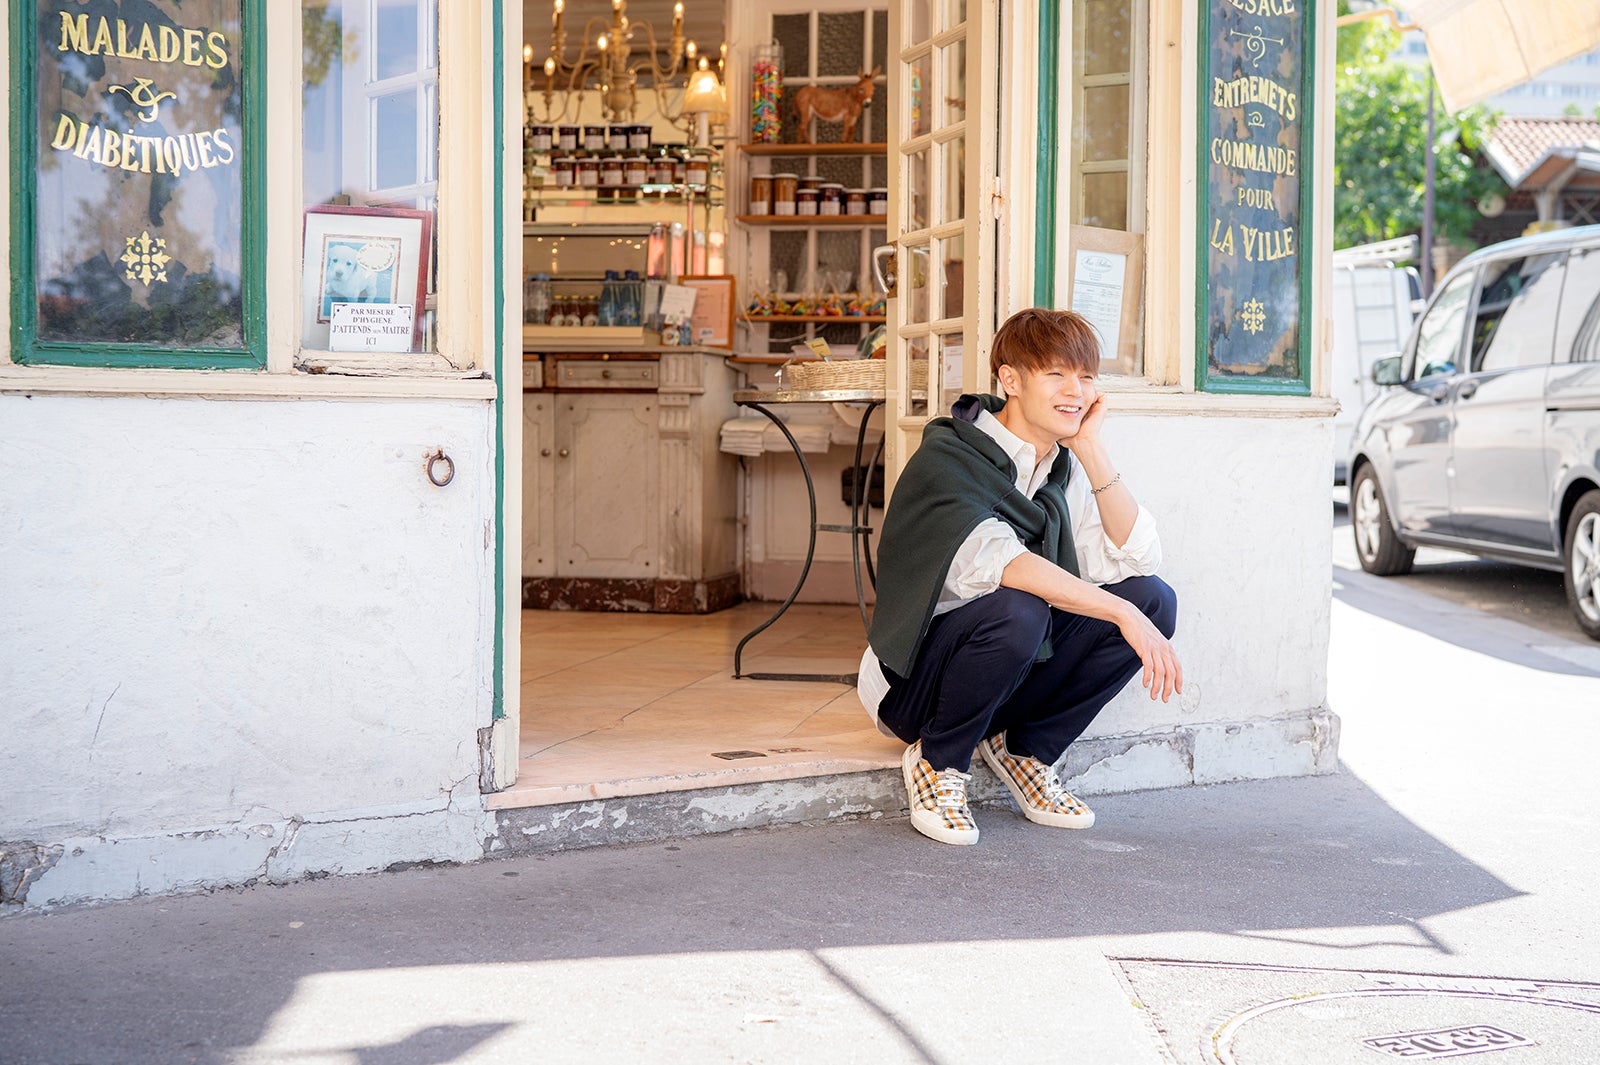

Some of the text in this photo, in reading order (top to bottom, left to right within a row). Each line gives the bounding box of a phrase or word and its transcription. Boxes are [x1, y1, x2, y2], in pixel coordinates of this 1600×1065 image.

[58, 11, 228, 69] MALADES
[1213, 75, 1297, 121] ENTREMETS
[51, 113, 234, 177] DIABÉTIQUES
[1210, 138, 1296, 177] COMMANDE
[1237, 186, 1275, 211] POUR
[1210, 218, 1295, 262] LA VILLE
[332, 325, 372, 334] J'ATTENDS
[366, 308, 395, 316] MESURE
[365, 337, 377, 345] ICI
